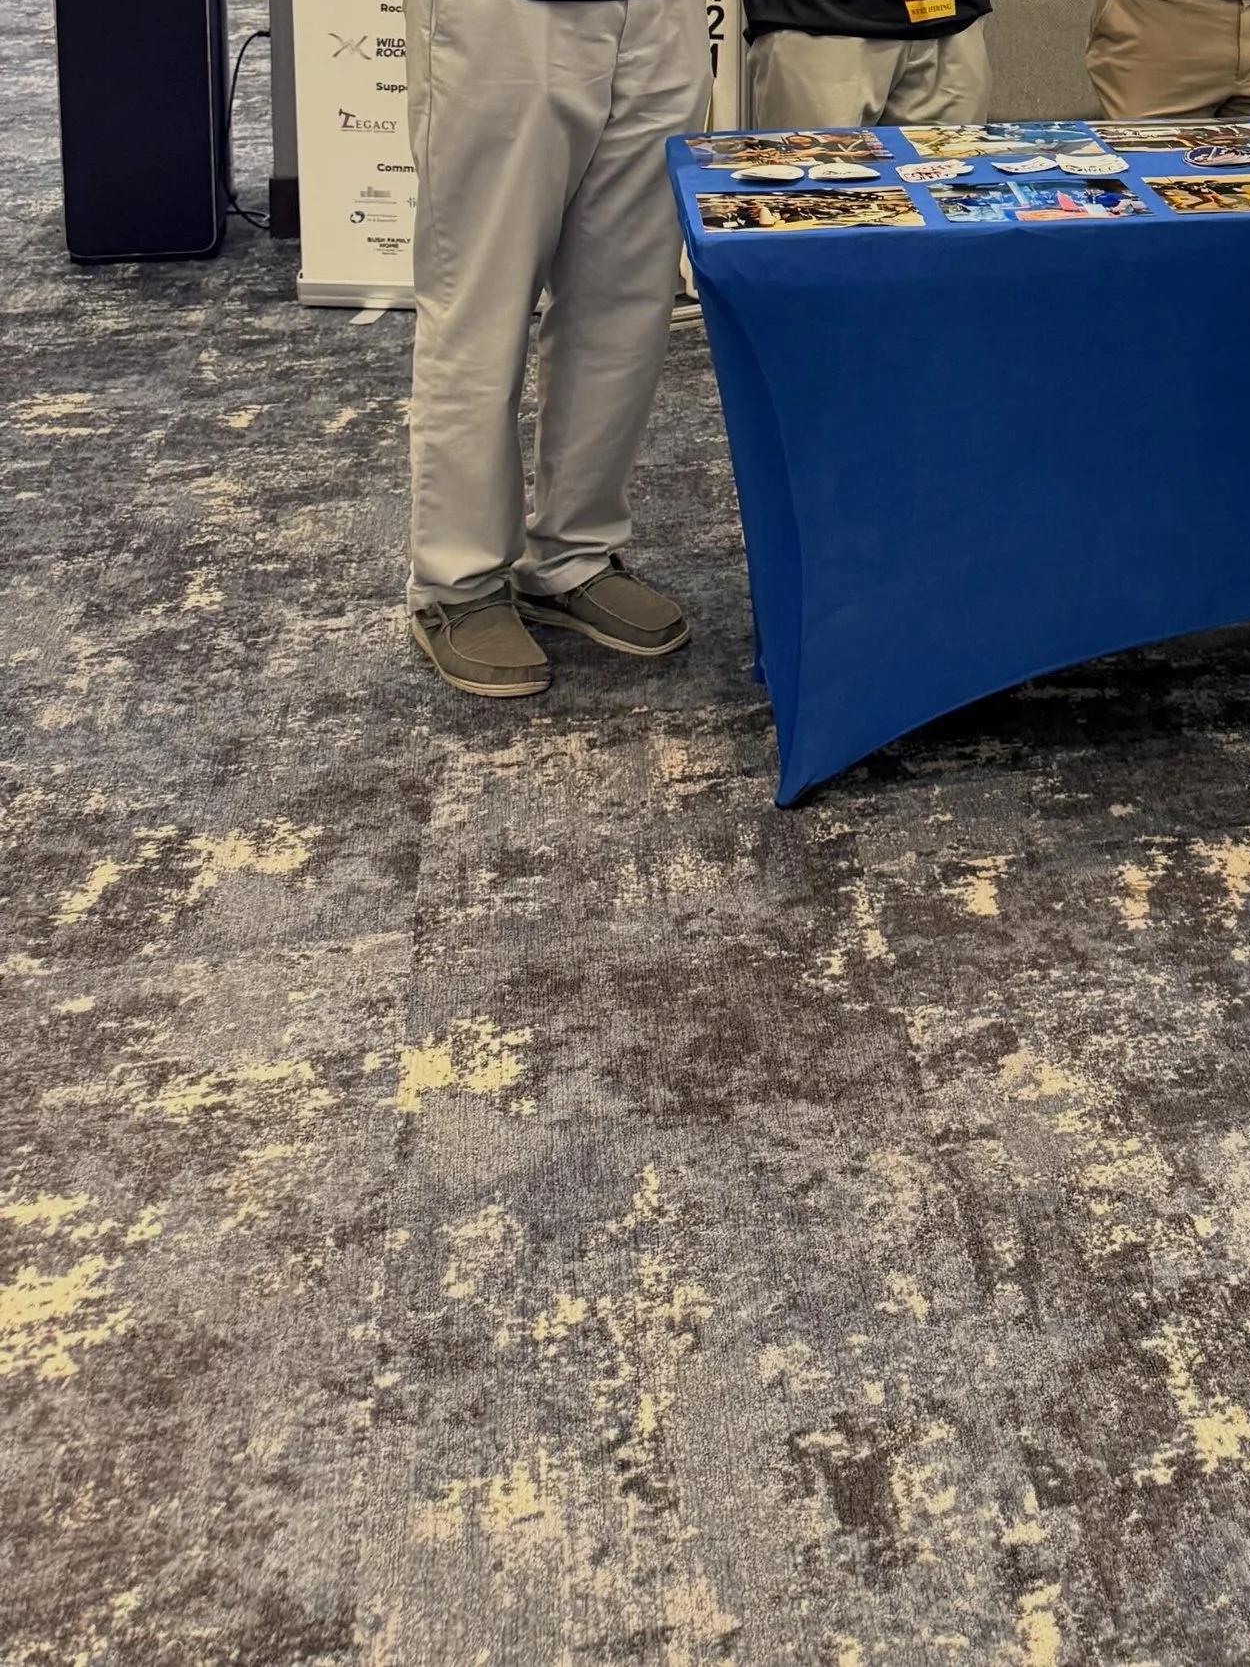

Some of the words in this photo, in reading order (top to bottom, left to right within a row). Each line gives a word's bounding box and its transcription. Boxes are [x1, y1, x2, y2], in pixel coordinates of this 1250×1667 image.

[376, 38, 405, 47] WILD
[376, 48, 406, 57] ROCK
[377, 163, 414, 173] Comm
